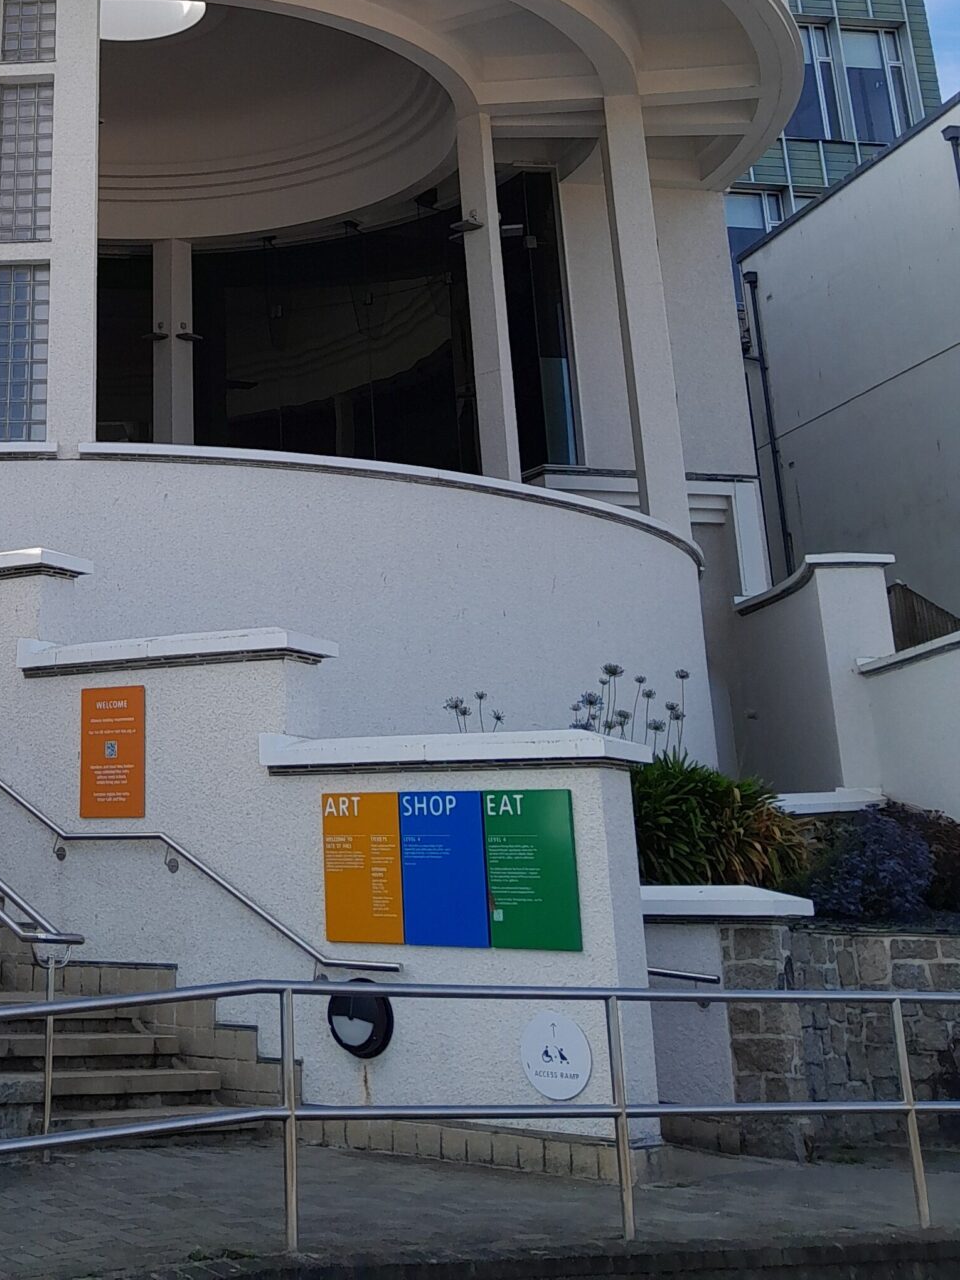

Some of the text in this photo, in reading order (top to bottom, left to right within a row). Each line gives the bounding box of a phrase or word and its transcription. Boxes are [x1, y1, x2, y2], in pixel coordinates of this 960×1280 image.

[96, 700, 128, 709] WELCOME
[324, 796, 361, 817] ART
[402, 795, 457, 816] SHOP
[486, 794, 524, 816] EAT
[534, 1070, 580, 1080] ACCESS RAMP
